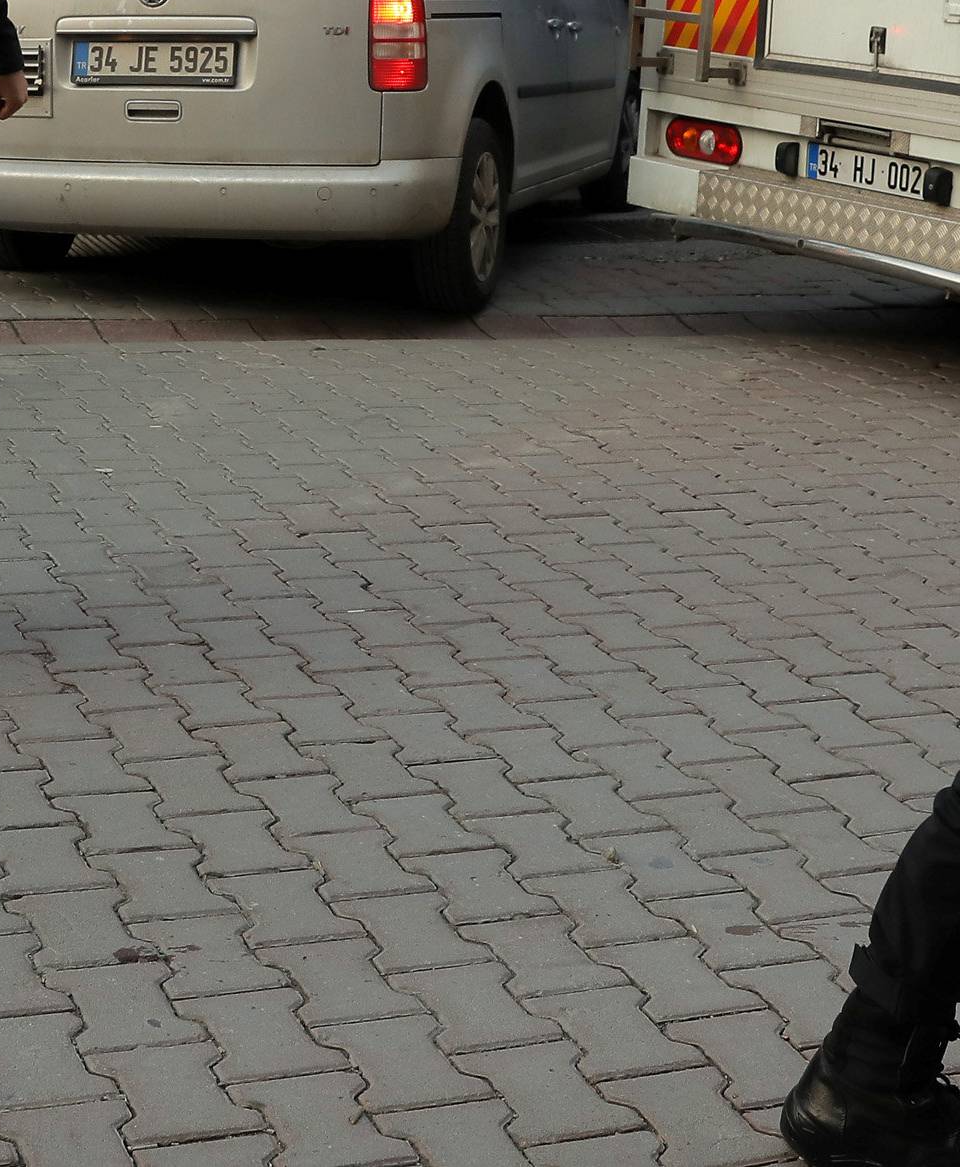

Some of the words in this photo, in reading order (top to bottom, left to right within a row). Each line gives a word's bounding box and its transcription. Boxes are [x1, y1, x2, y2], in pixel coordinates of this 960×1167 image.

[89, 45, 118, 73] 34
[129, 45, 159, 73] JE
[169, 45, 228, 74] 5925
[818, 149, 838, 178] 34
[853, 155, 876, 185] HJ
